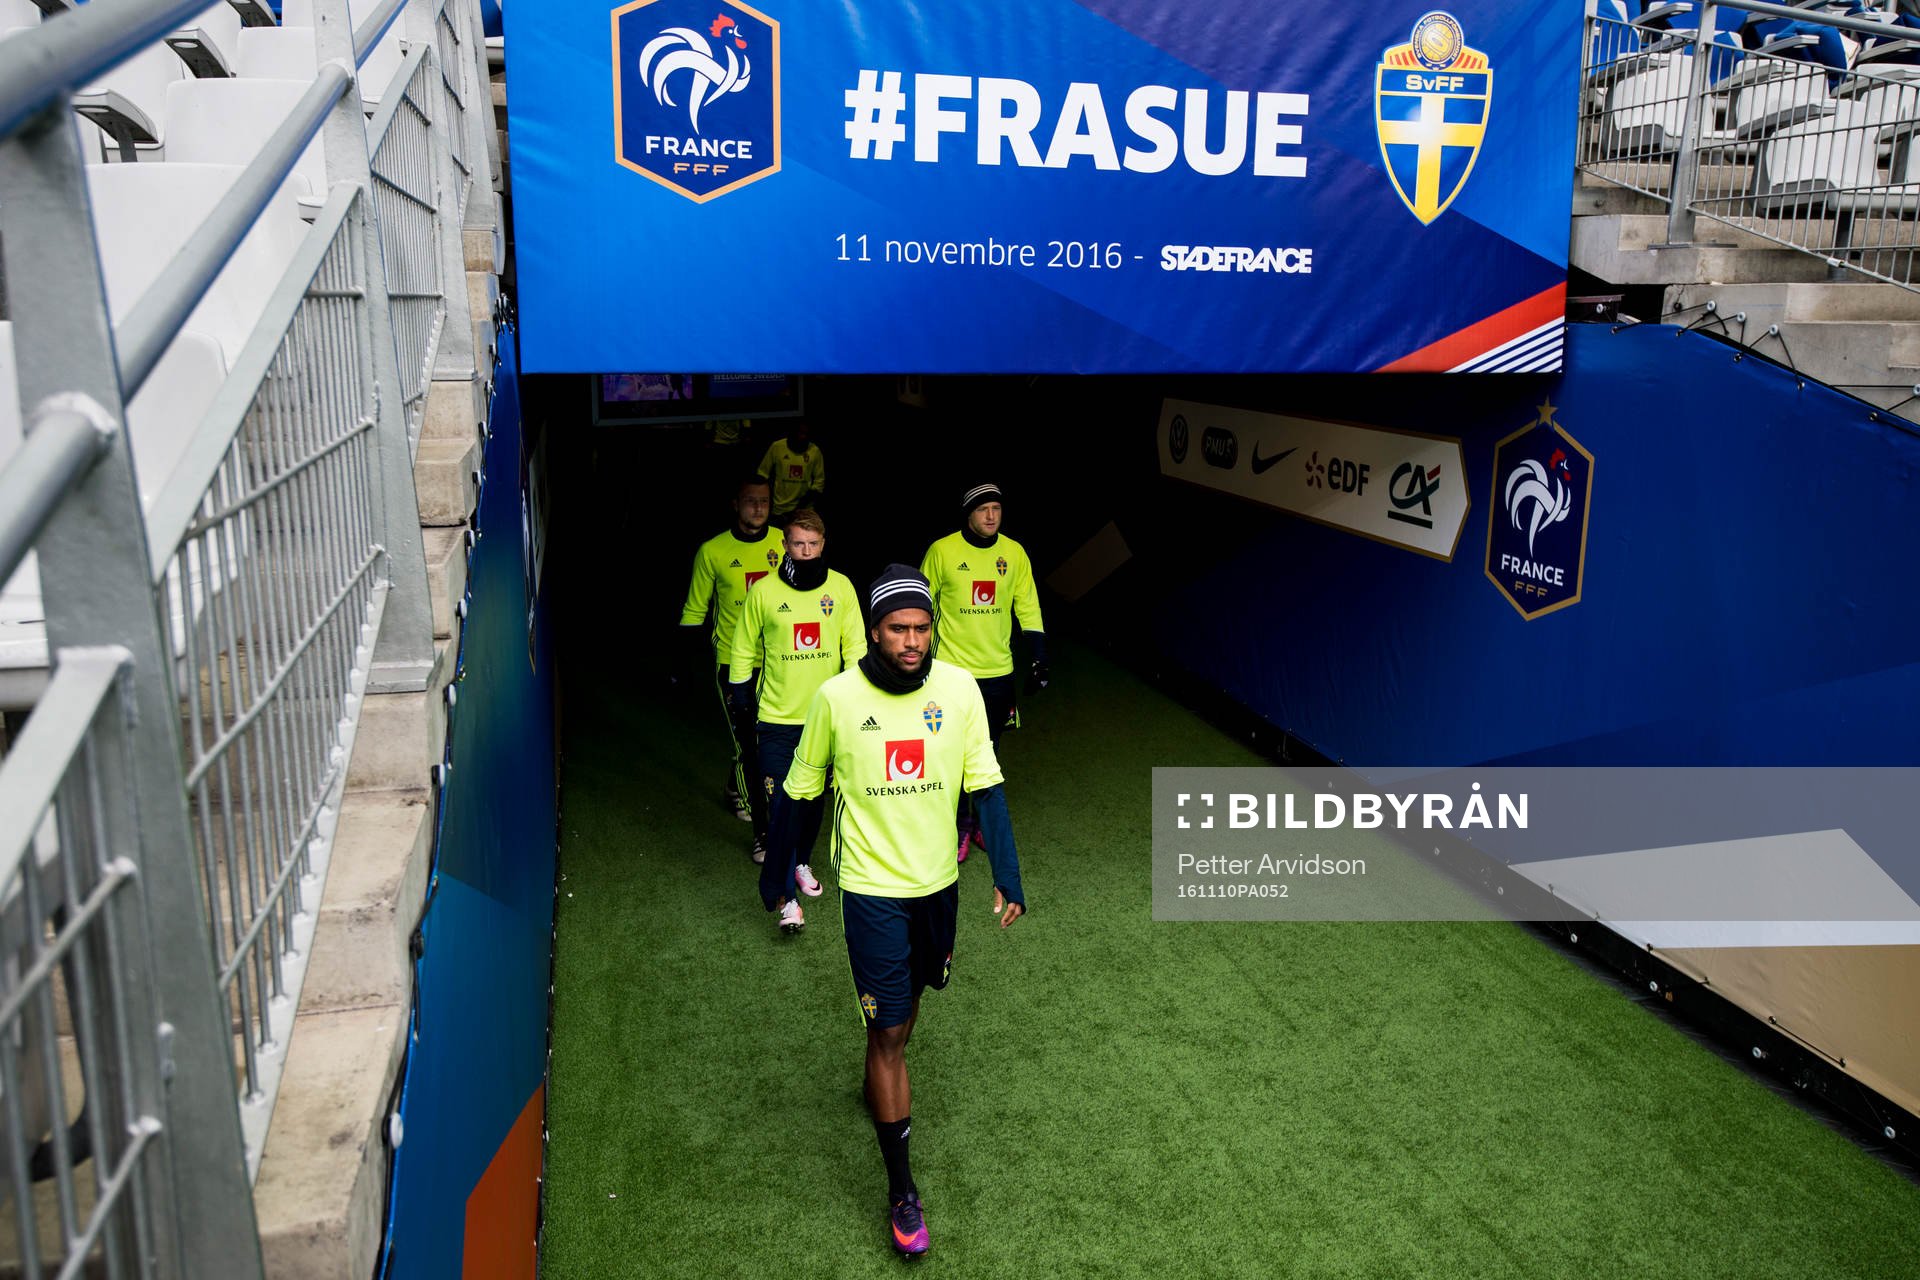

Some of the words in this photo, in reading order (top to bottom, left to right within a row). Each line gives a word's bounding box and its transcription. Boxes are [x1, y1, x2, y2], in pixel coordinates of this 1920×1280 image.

[1406, 74, 1464, 92] SvFF
[844, 69, 1310, 178] #FRASUE
[645, 135, 753, 159] FRANCE
[673, 162, 730, 176] FFF
[835, 233, 871, 262] 11
[885, 237, 1036, 268] novembre
[1046, 240, 1123, 269] 2016
[1500, 553, 1564, 587] FRANCE
[1514, 580, 1548, 598] FFF
[960, 607, 990, 615] SVENSKA
[781, 653, 815, 662] SVENSKA
[866, 785, 917, 797] SVENSKA
[920, 781, 944, 793] SPEL
